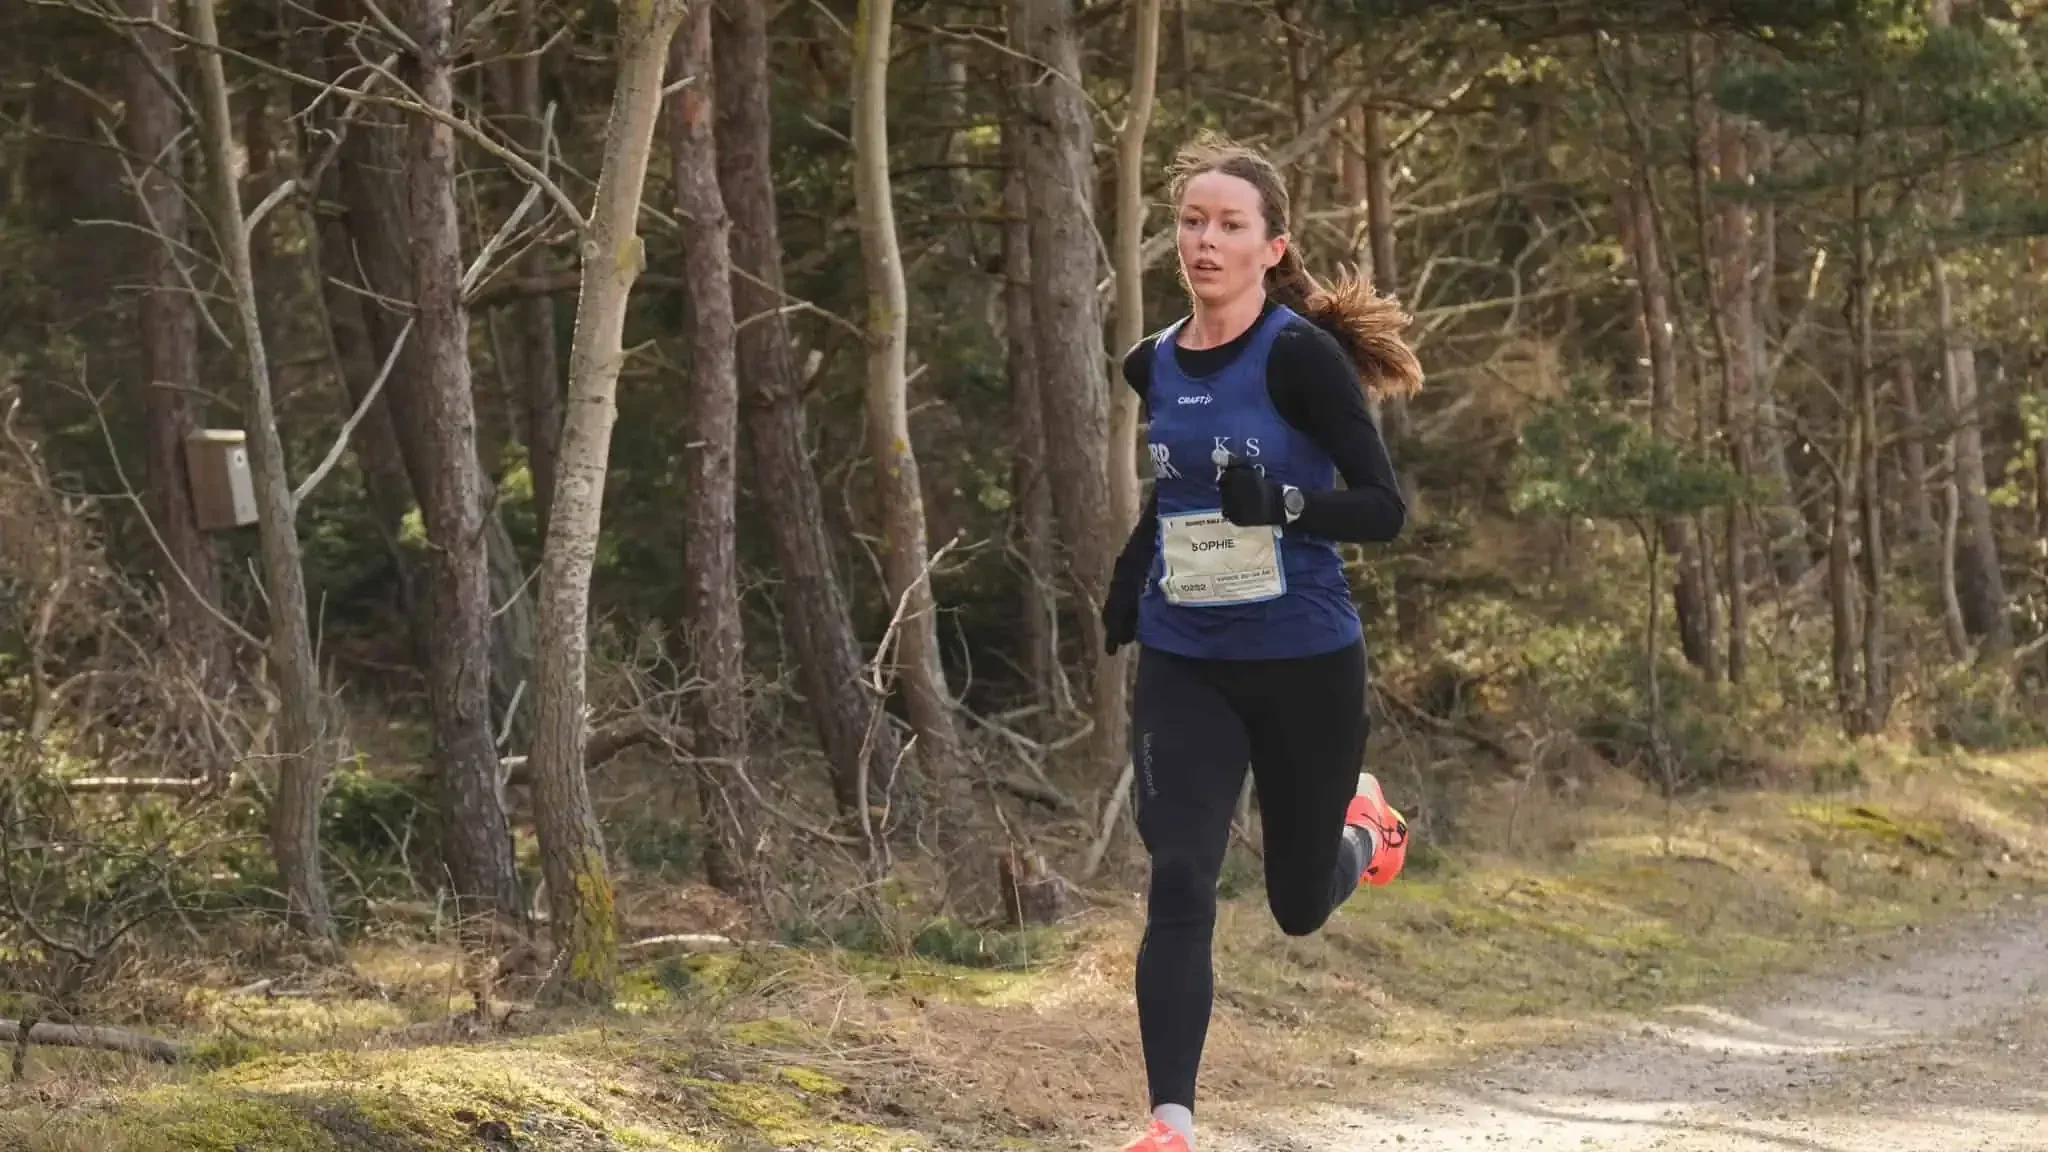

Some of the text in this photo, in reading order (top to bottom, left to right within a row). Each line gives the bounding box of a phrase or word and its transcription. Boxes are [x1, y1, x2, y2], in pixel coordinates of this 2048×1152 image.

[1178, 395, 1205, 405] CRAFT
[1246, 438, 1260, 457] S
[1191, 538, 1236, 552] SOPHIE
